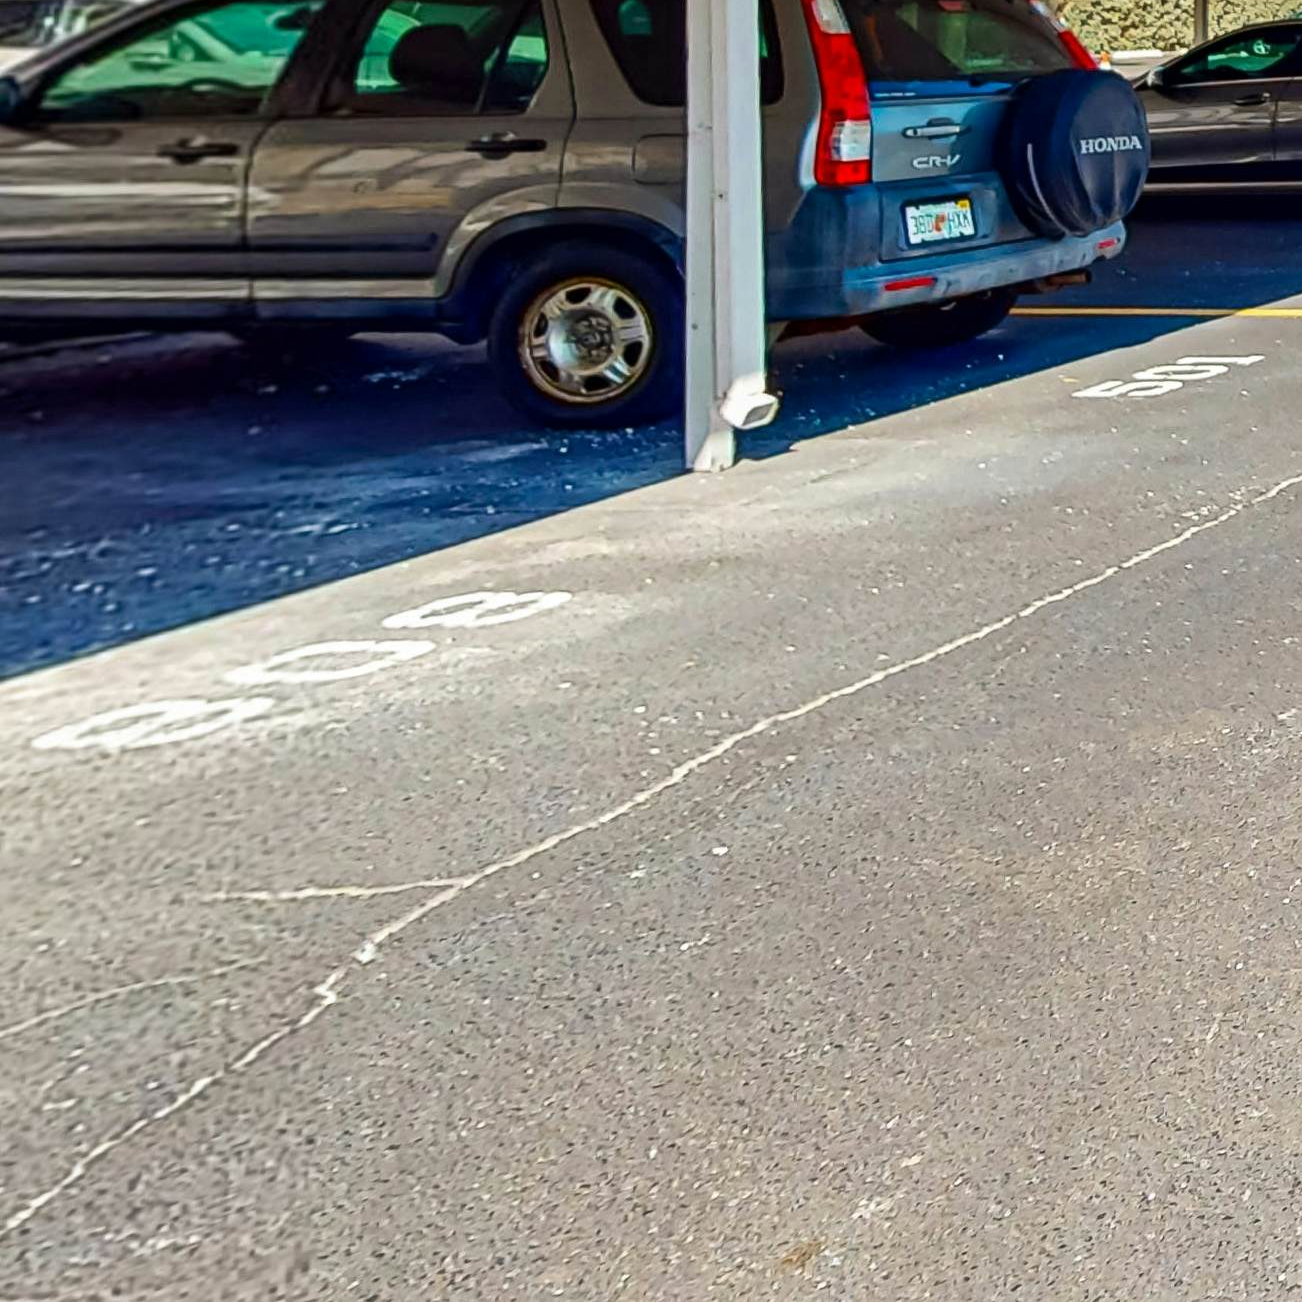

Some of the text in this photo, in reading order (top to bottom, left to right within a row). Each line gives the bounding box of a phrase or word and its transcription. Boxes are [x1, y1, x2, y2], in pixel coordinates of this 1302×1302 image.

[1080, 135, 1142, 154] HONDA
[912, 154, 961, 170] CR-V
[1070, 354, 1266, 398] 501
